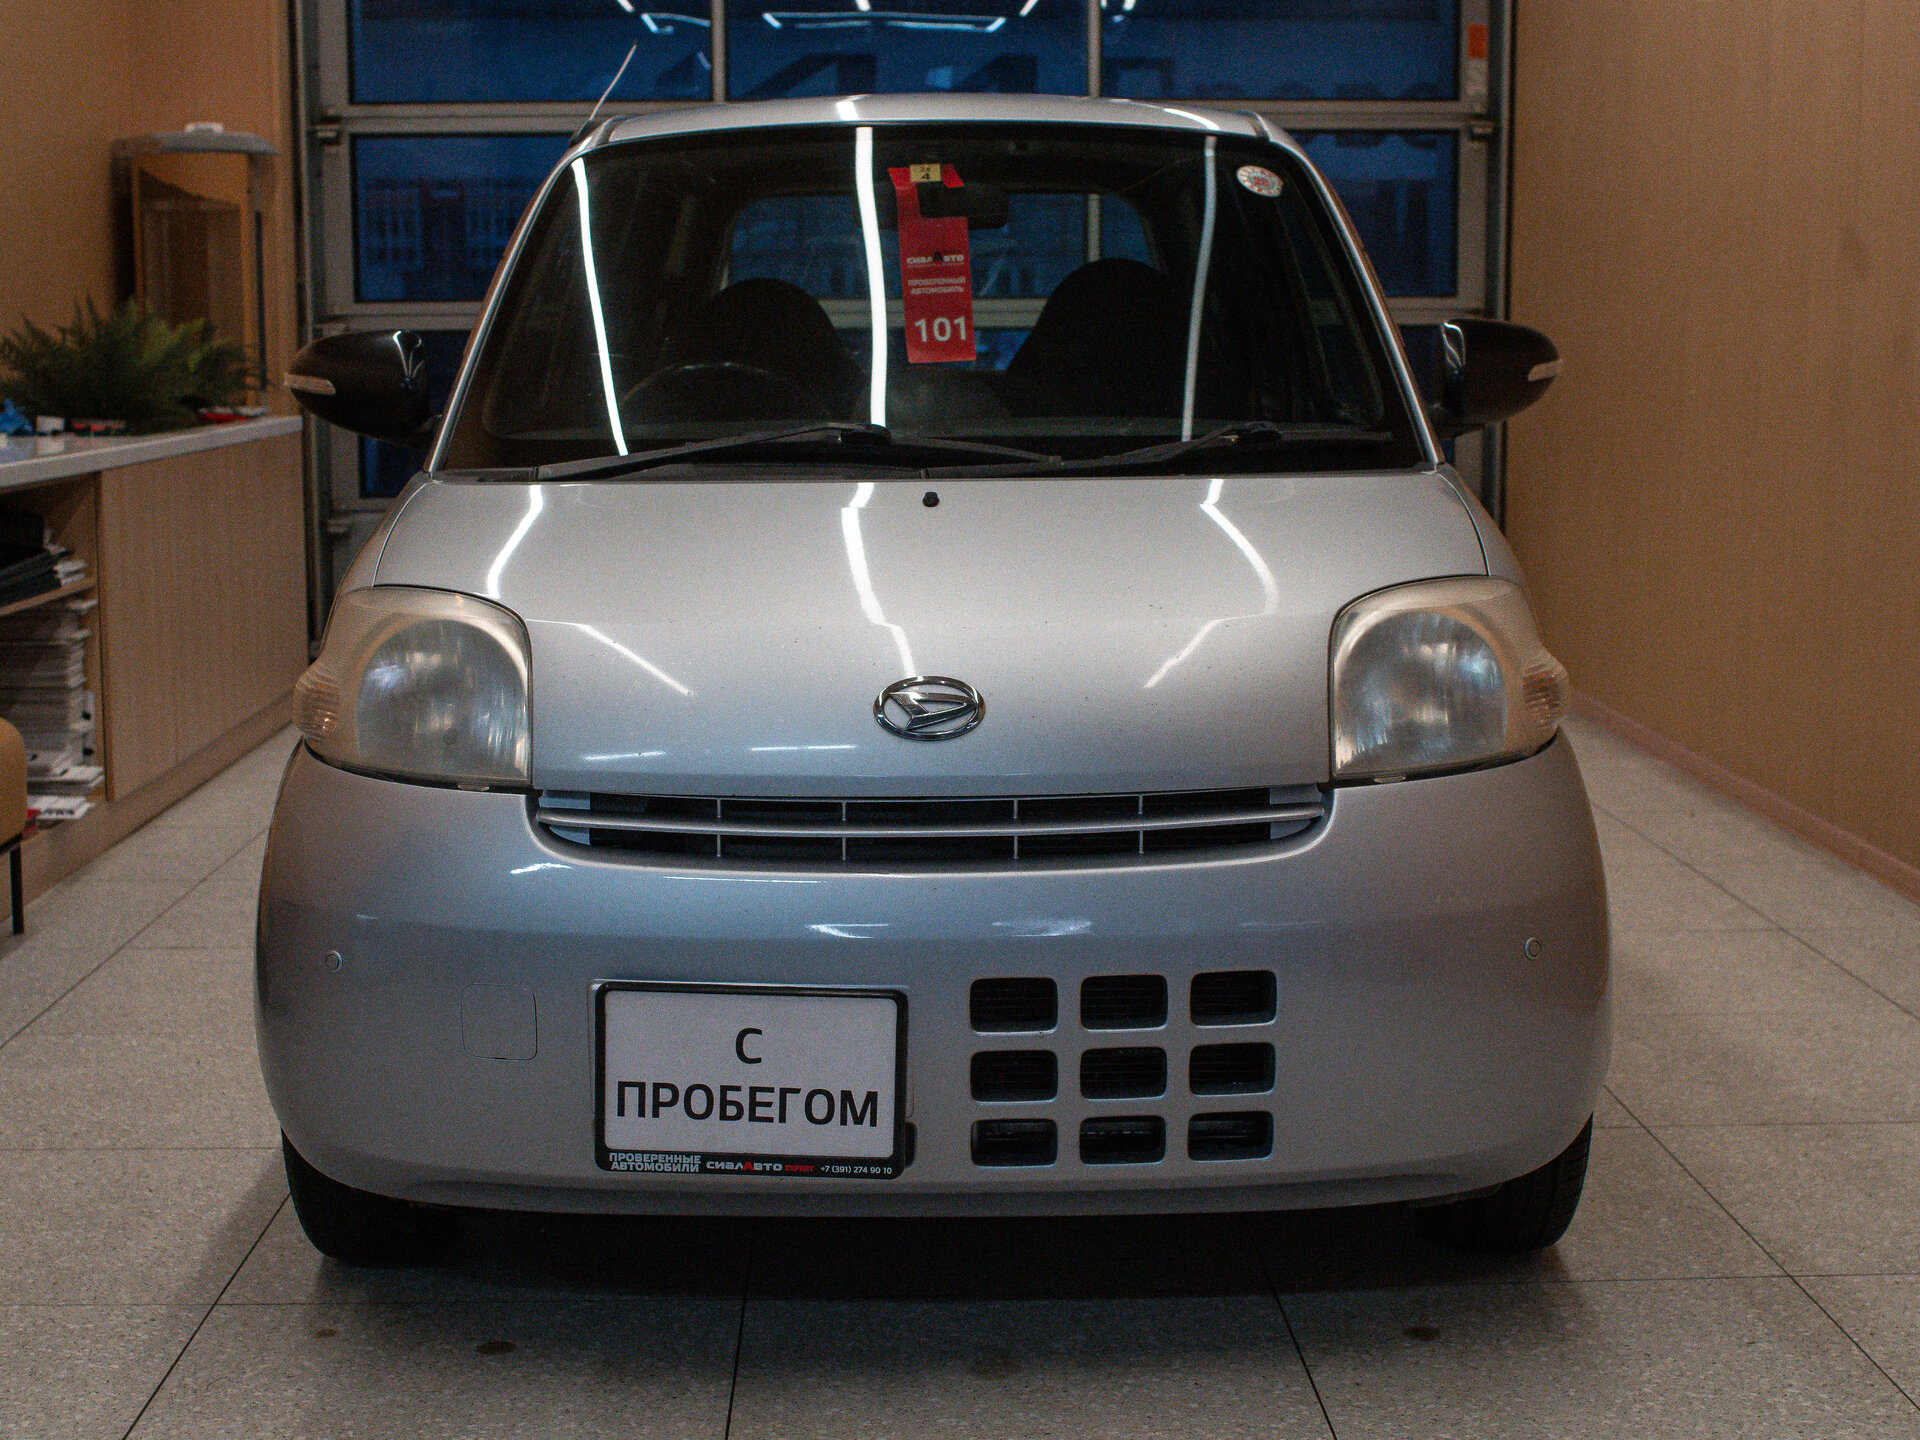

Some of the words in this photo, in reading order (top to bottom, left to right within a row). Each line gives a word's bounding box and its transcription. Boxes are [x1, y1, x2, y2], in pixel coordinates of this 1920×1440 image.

[915, 317, 966, 342] 101
[735, 1028, 763, 1064] С
[616, 1080, 878, 1128] ПРОБЕГОМ
[609, 1152, 701, 1164] ПРОВЕРЕННЫЕ
[611, 1161, 700, 1172] АВТОМОБИЛИ
[820, 1165, 831, 1173] +7
[831, 1165, 852, 1174] (391)
[853, 1166, 868, 1174] 274
[870, 1166, 881, 1174] 90
[883, 1167, 893, 1175] 10
